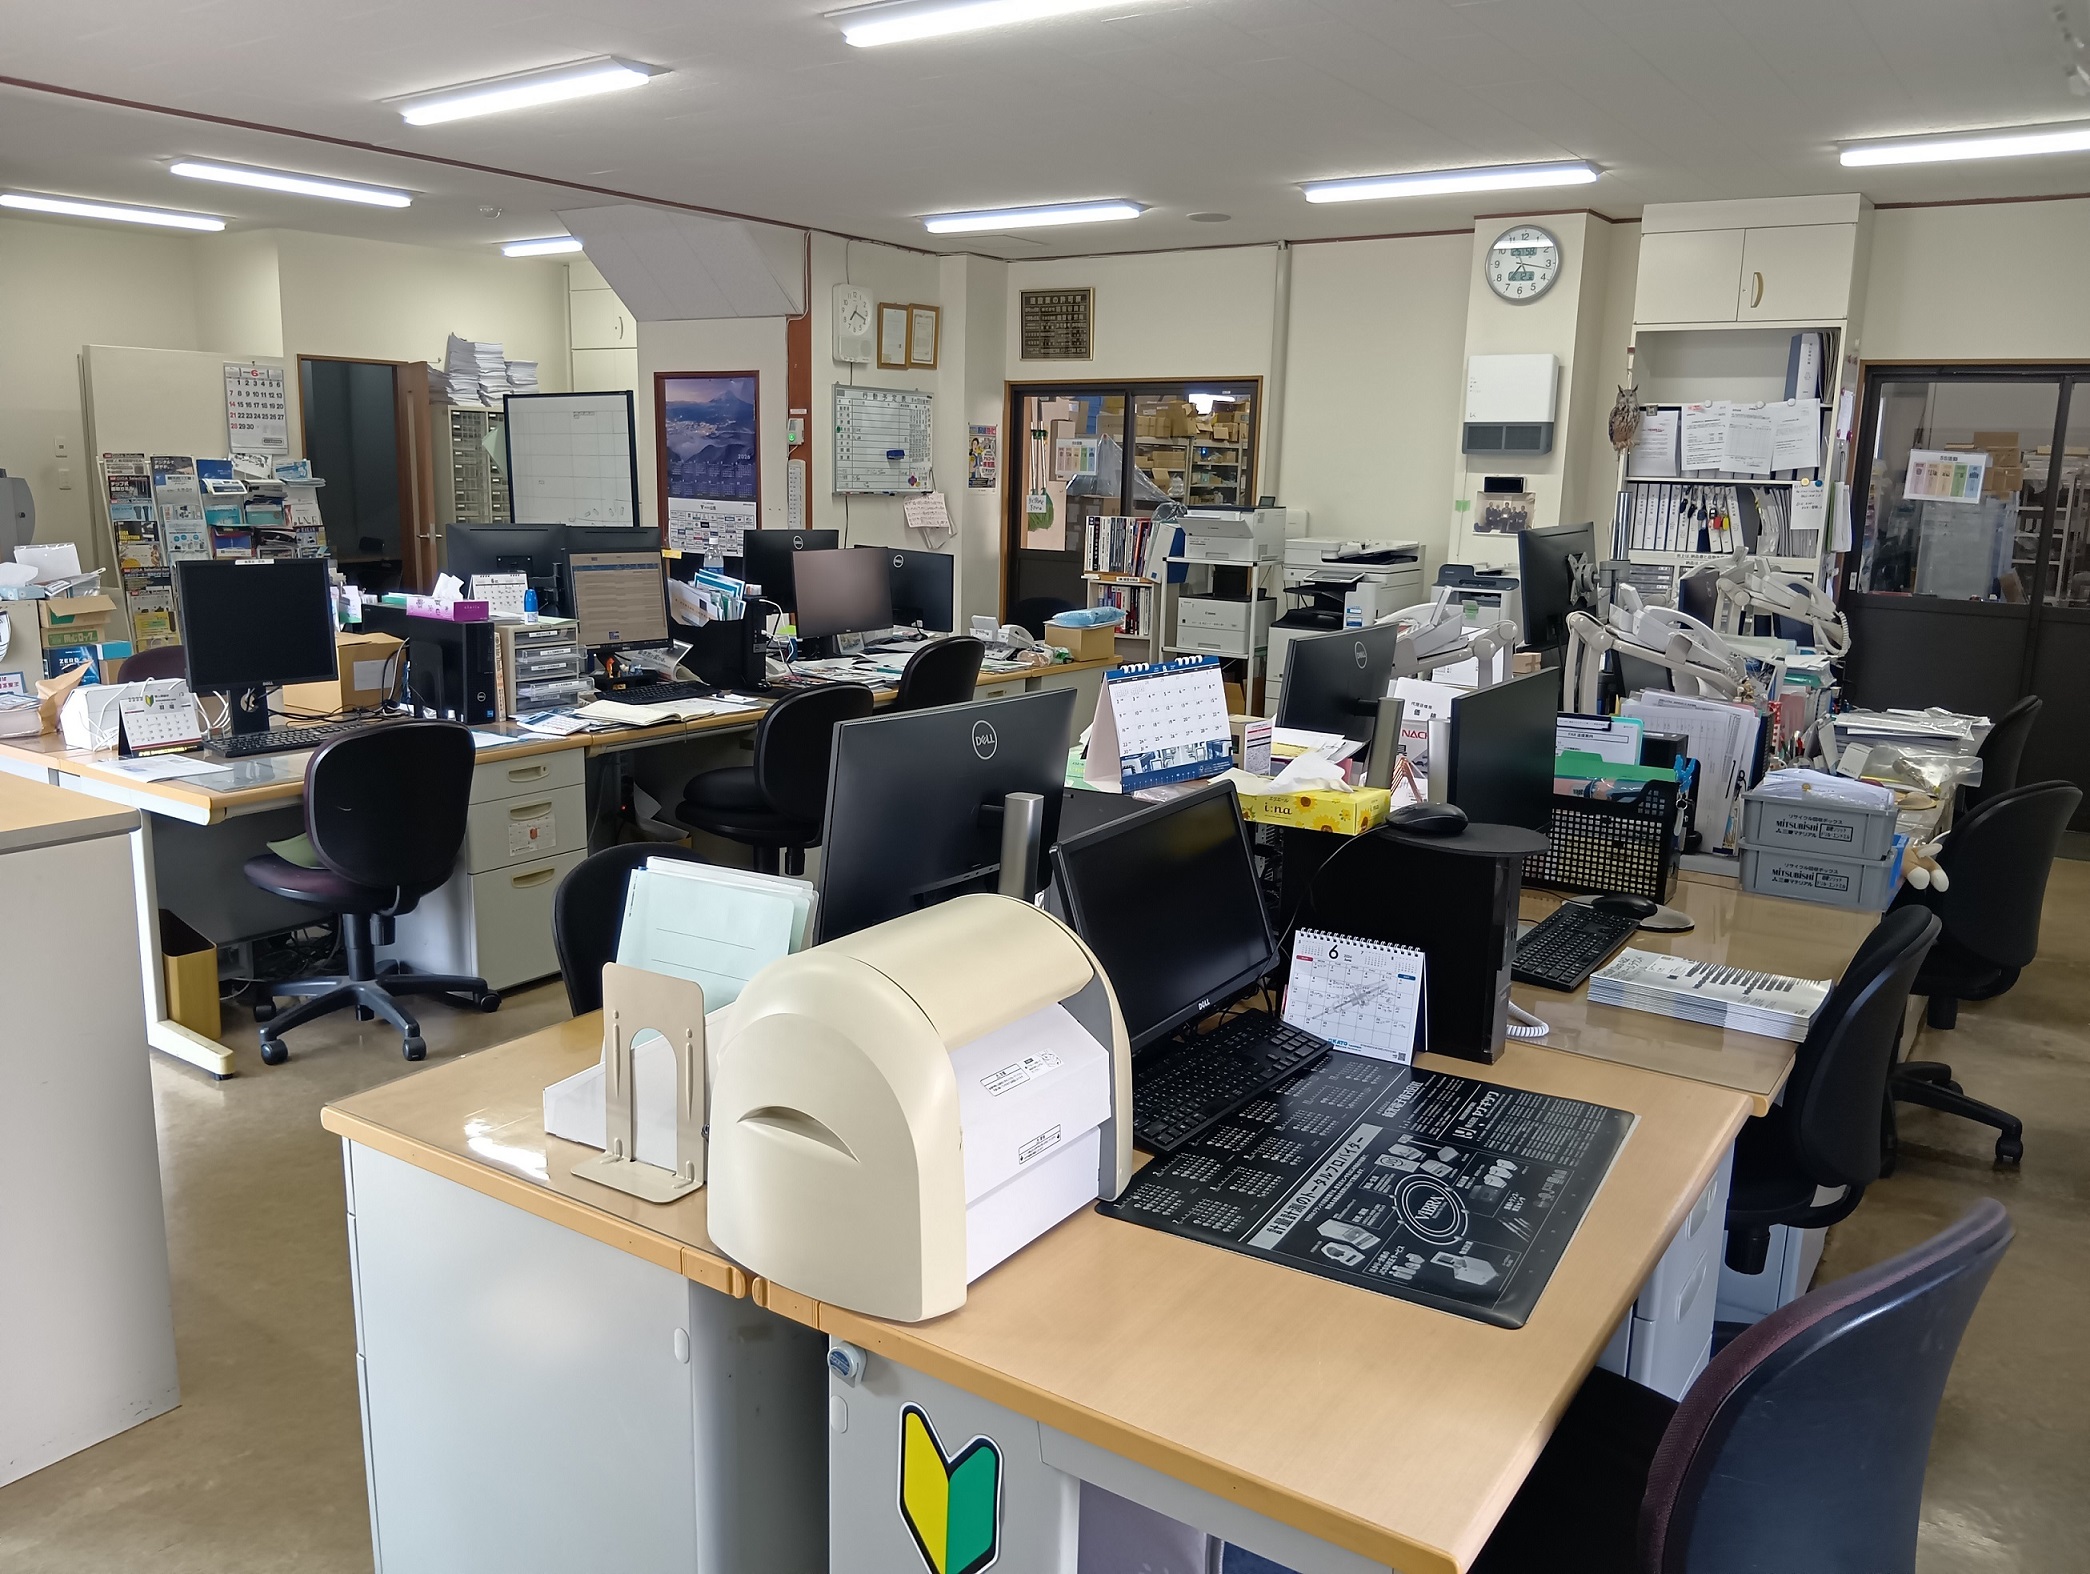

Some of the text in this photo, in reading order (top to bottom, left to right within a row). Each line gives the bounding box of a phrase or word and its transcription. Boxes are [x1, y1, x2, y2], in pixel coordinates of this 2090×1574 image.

[975, 734, 996, 746] DELL
[1264, 802, 1292, 814] i:na
[1329, 944, 1338, 959] 6
[1198, 998, 1210, 1010] DELL
[1379, 1080, 1425, 1118] 新光電子株式会社
[1264, 1135, 1372, 1234] 計量計測のトータルプロバイダー
